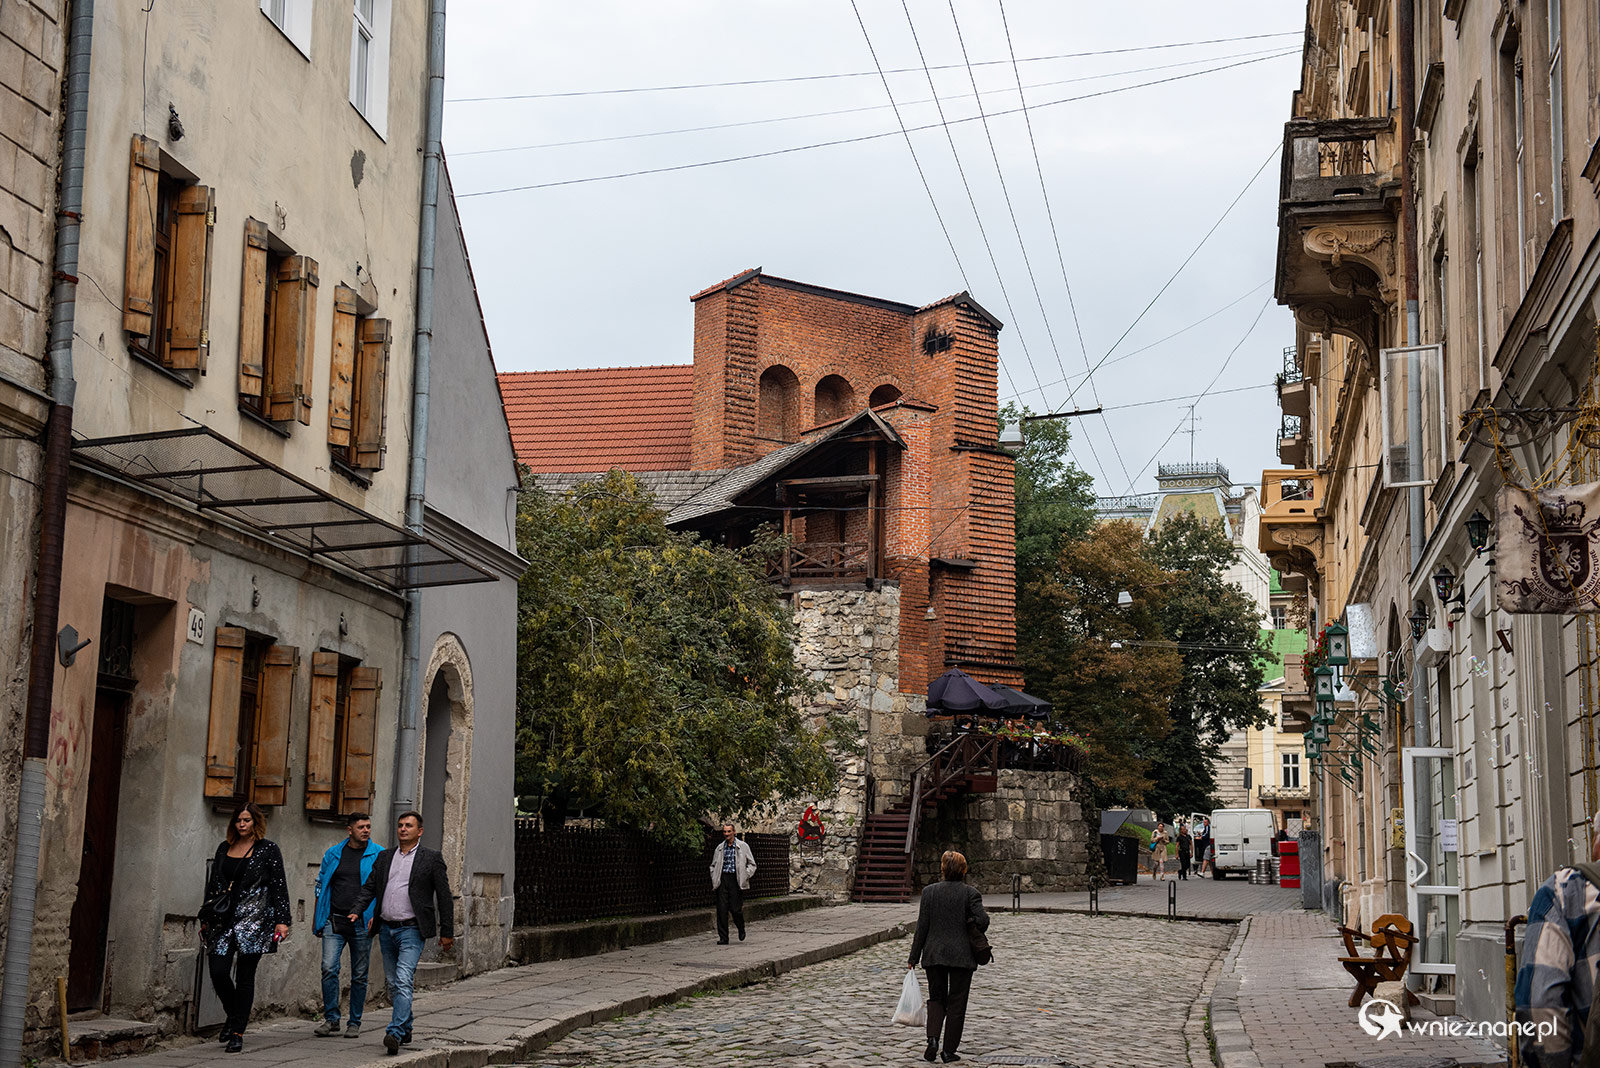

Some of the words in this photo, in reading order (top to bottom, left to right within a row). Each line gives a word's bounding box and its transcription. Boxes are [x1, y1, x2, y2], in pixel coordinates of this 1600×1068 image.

[1531, 549, 1539, 564] LVIV
[1531, 566, 1555, 596] SOUVENIR
[1578, 549, 1600, 595] MANUFACTURE
[191, 614, 203, 638] 49
